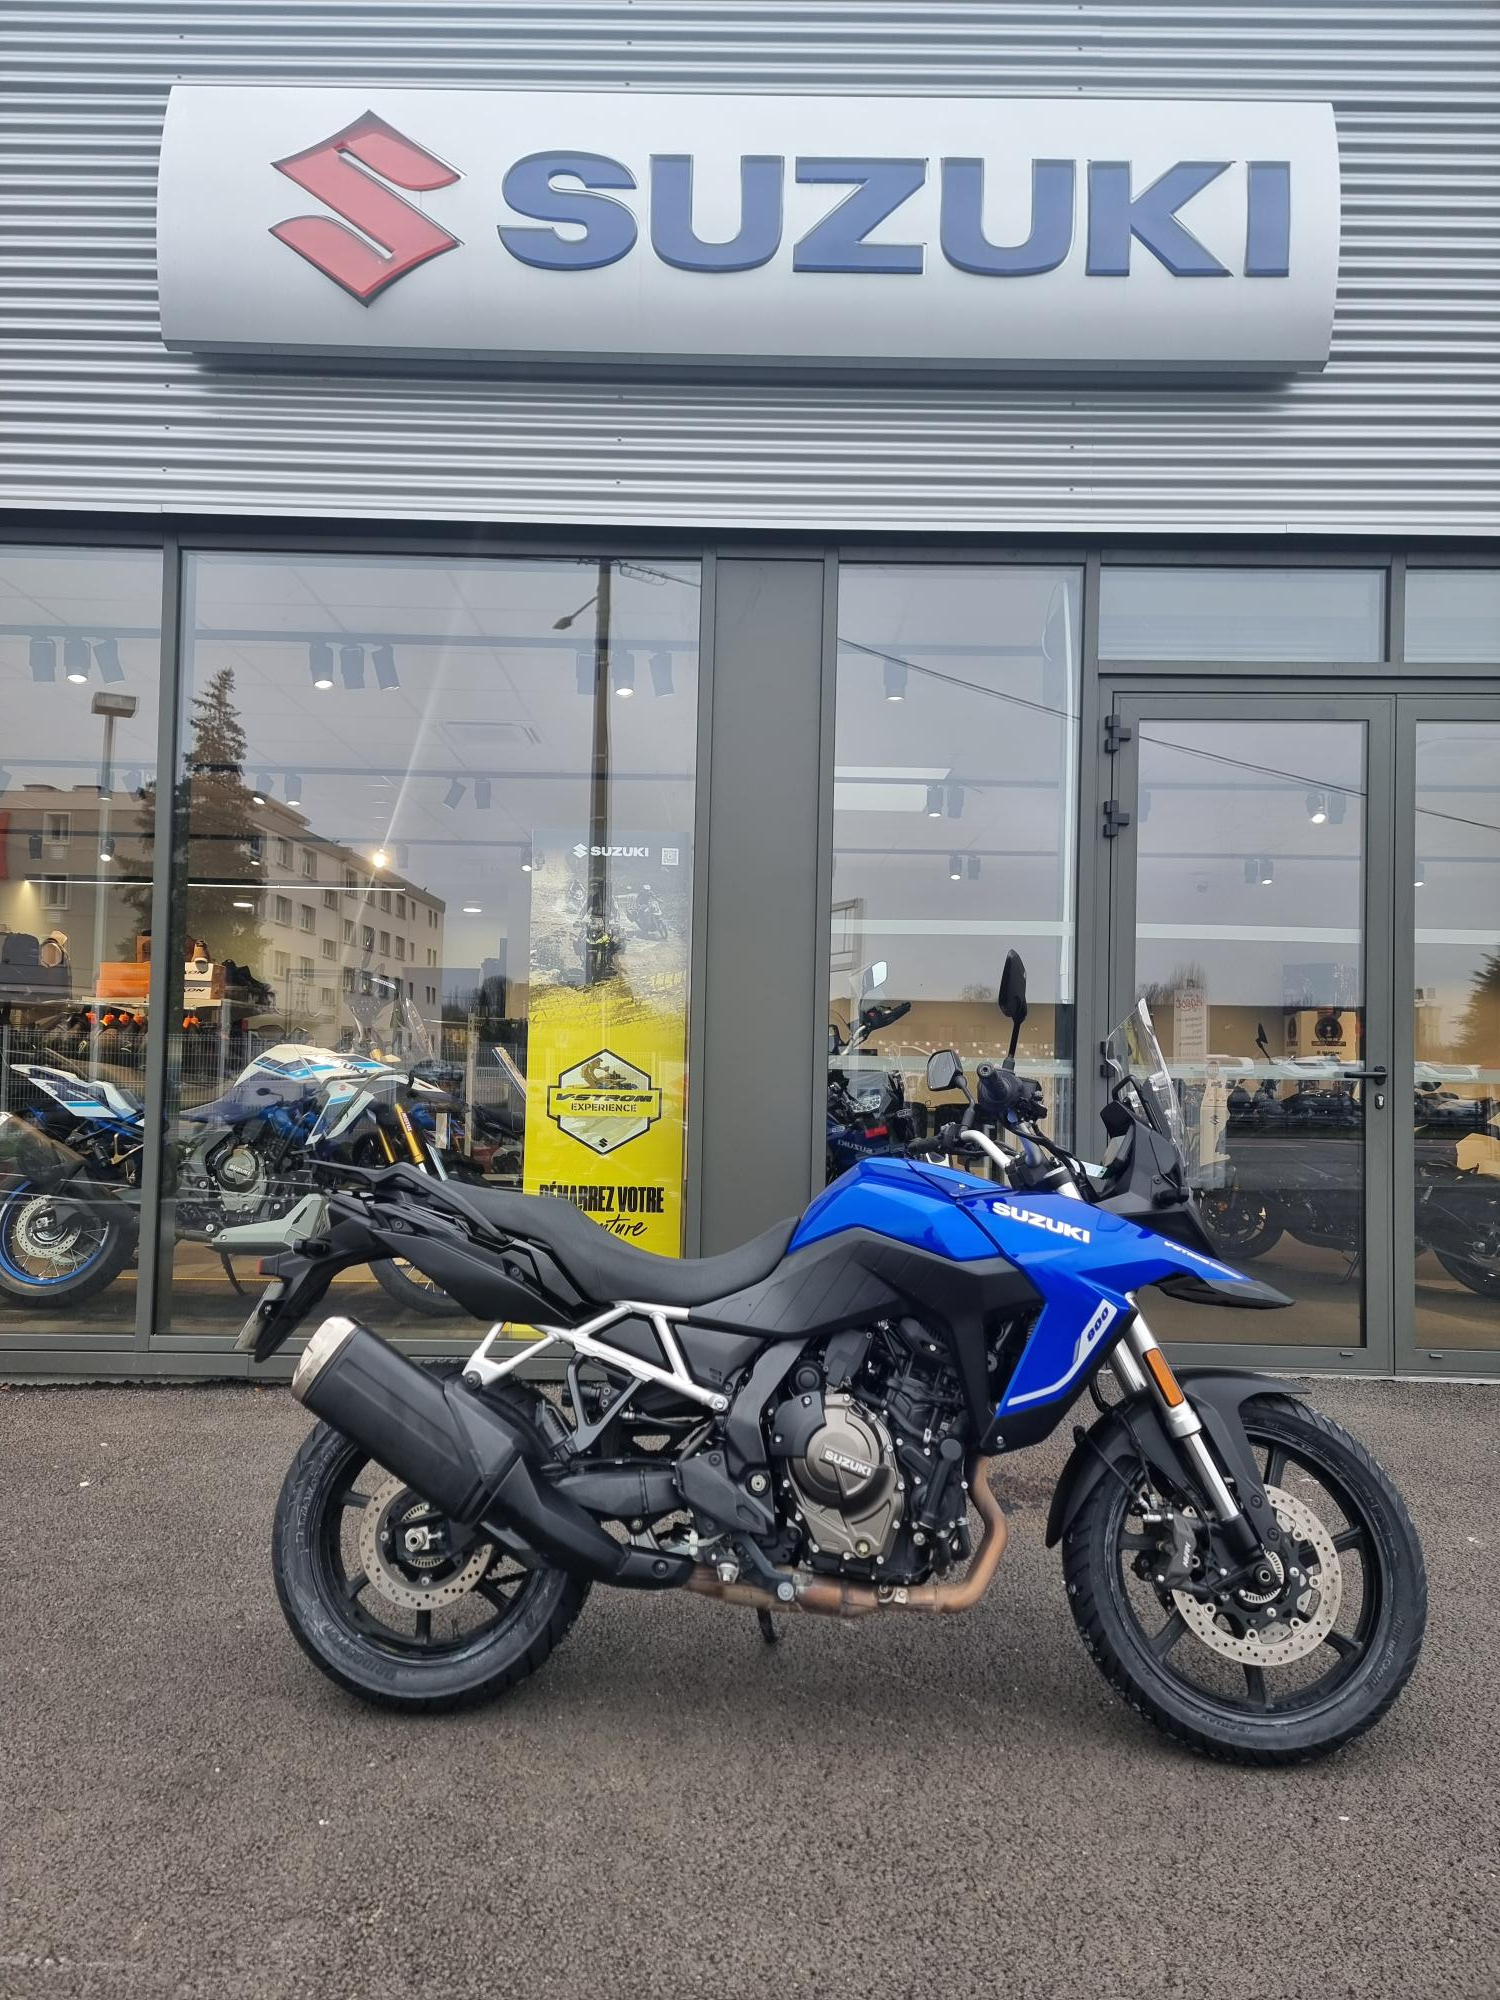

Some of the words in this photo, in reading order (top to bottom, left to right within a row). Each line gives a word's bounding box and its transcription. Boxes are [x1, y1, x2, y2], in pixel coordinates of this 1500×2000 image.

[497, 150, 1290, 278] SUZUKI
[590, 845, 649, 858] SUZUKI
[555, 1093, 653, 1103] V-STROM
[571, 1102, 637, 1113] EXPERIENCE
[617, 1186, 665, 1213] VOTRE
[992, 1201, 1091, 1244] SUZUKI
[1087, 1306, 1109, 1342] 800
[824, 1450, 872, 1477] SUZUKI
